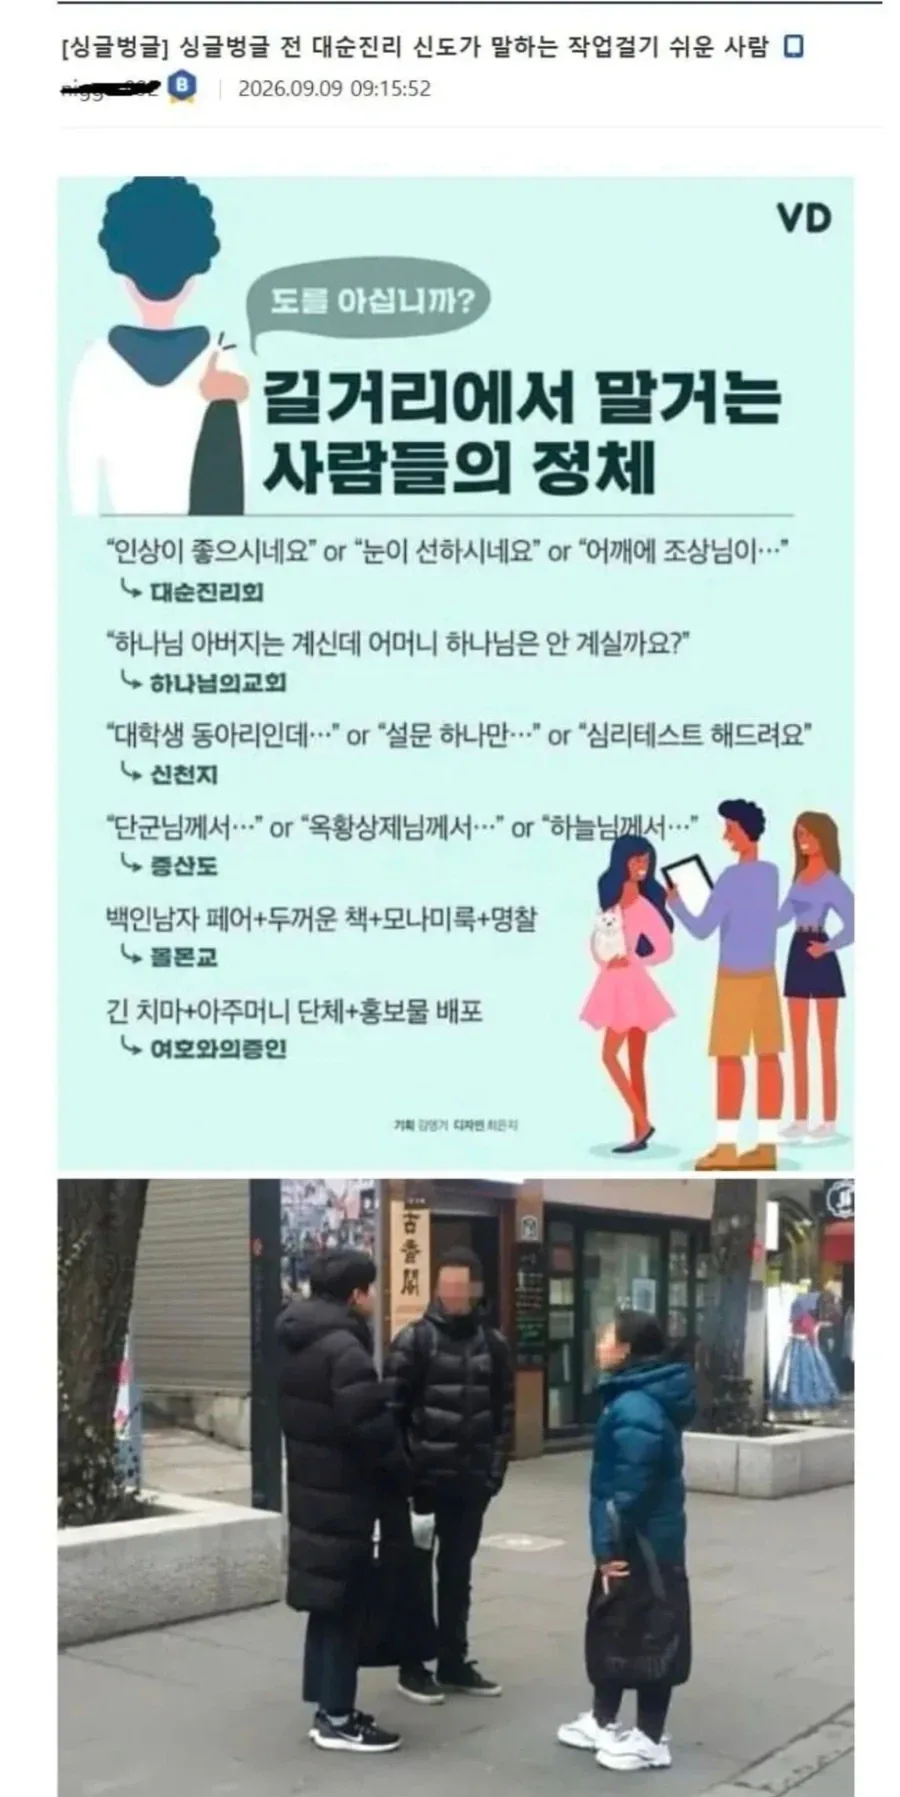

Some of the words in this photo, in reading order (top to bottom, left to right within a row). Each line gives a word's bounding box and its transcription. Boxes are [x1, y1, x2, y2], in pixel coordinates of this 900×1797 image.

[62, 35, 168, 61] [싱글벙글]
[180, 35, 270, 58] 싱글벙글
[281, 36, 301, 58] 전
[313, 35, 401, 58] 대순진리
[414, 35, 481, 58] 신도가
[492, 35, 558, 58] 말하는
[569, 35, 658, 58] 작업걸기
[669, 35, 714, 58] 쉬운
[724, 35, 769, 58] 사람
[176, 77, 189, 92] B
[239, 80, 343, 97] 2026.09.09
[351, 80, 431, 97] 09:15:52
[776, 202, 832, 233] VD
[271, 288, 328, 314] 도를
[338, 287, 476, 315] 아십니까?
[264, 370, 573, 424] 길거리에서
[596, 370, 781, 424] 말거는
[264, 441, 510, 494] 사람들의
[534, 441, 654, 495] 정체
[324, 545, 347, 562] or
[548, 545, 572, 562] or
[151, 583, 263, 602] 대순진리회
[192, 630, 285, 657] 아버지는
[292, 630, 360, 657] 계신데
[369, 630, 437, 657] 어머니
[446, 630, 540, 657] 하나님은
[546, 630, 570, 656] 안
[151, 673, 286, 693] 하나님의교회
[347, 729, 370, 746] or
[548, 729, 572, 746] or
[151, 765, 217, 785] 신천지
[270, 821, 294, 838] or
[512, 821, 535, 838] or
[152, 856, 217, 876] 증산도
[106, 906, 200, 932] 백인남자
[206, 906, 337, 933] 페어+두꺼운
[346, 906, 538, 933] 책+모나미룩+명찰
[151, 948, 217, 967] 몰몬교
[107, 998, 128, 1024] 긴
[137, 998, 289, 1025] 치마+아주머니
[298, 998, 429, 1025] 단체+홍보물
[437, 998, 483, 1025] 배포
[151, 1039, 286, 1059] 여호와의증인
[395, 1119, 415, 1131] 기획
